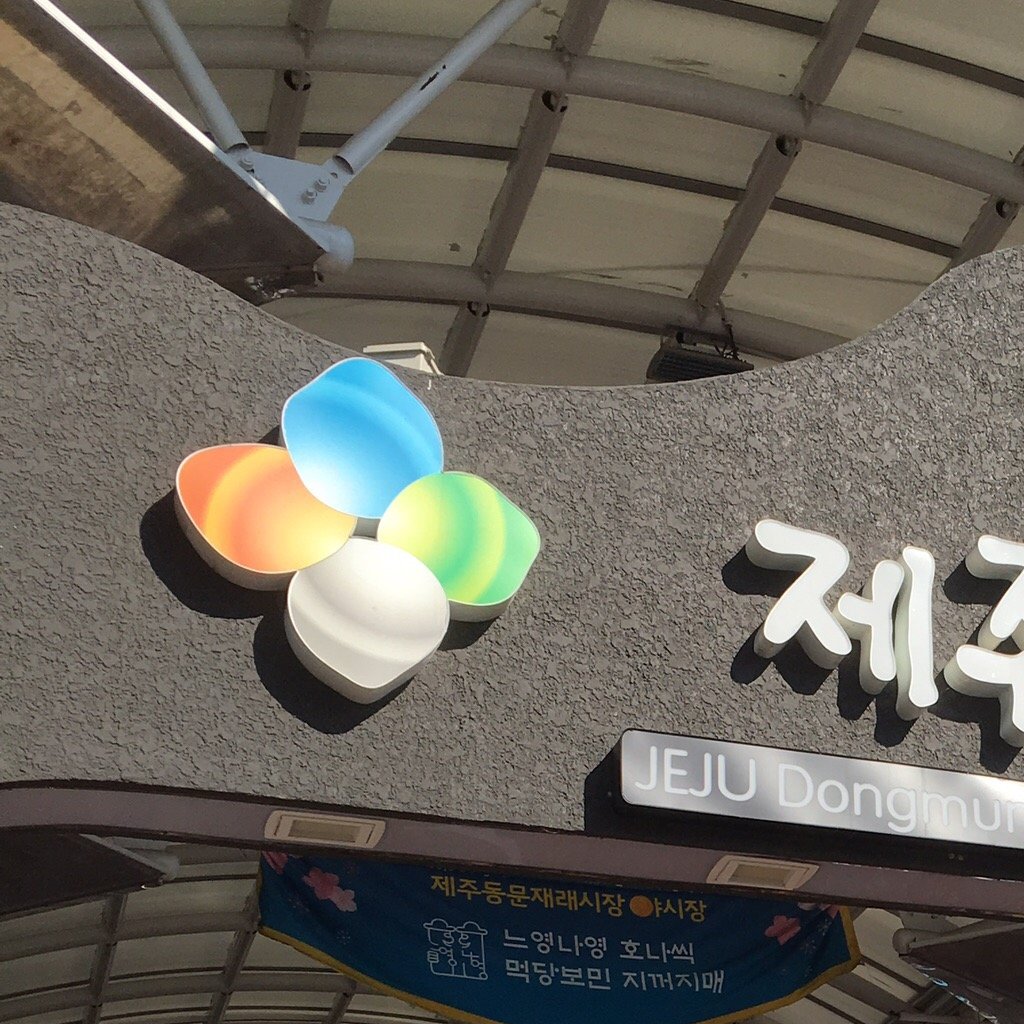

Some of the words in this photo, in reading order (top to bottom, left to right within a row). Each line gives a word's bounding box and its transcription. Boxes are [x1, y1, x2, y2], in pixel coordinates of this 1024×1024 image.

[634, 745, 756, 801] JEJU
[430, 872, 626, 918] 제주동문재래시장
[502, 928, 608, 961] 느영나영
[505, 958, 612, 992] 먹당보민
[621, 968, 725, 994] 지꺼지매
